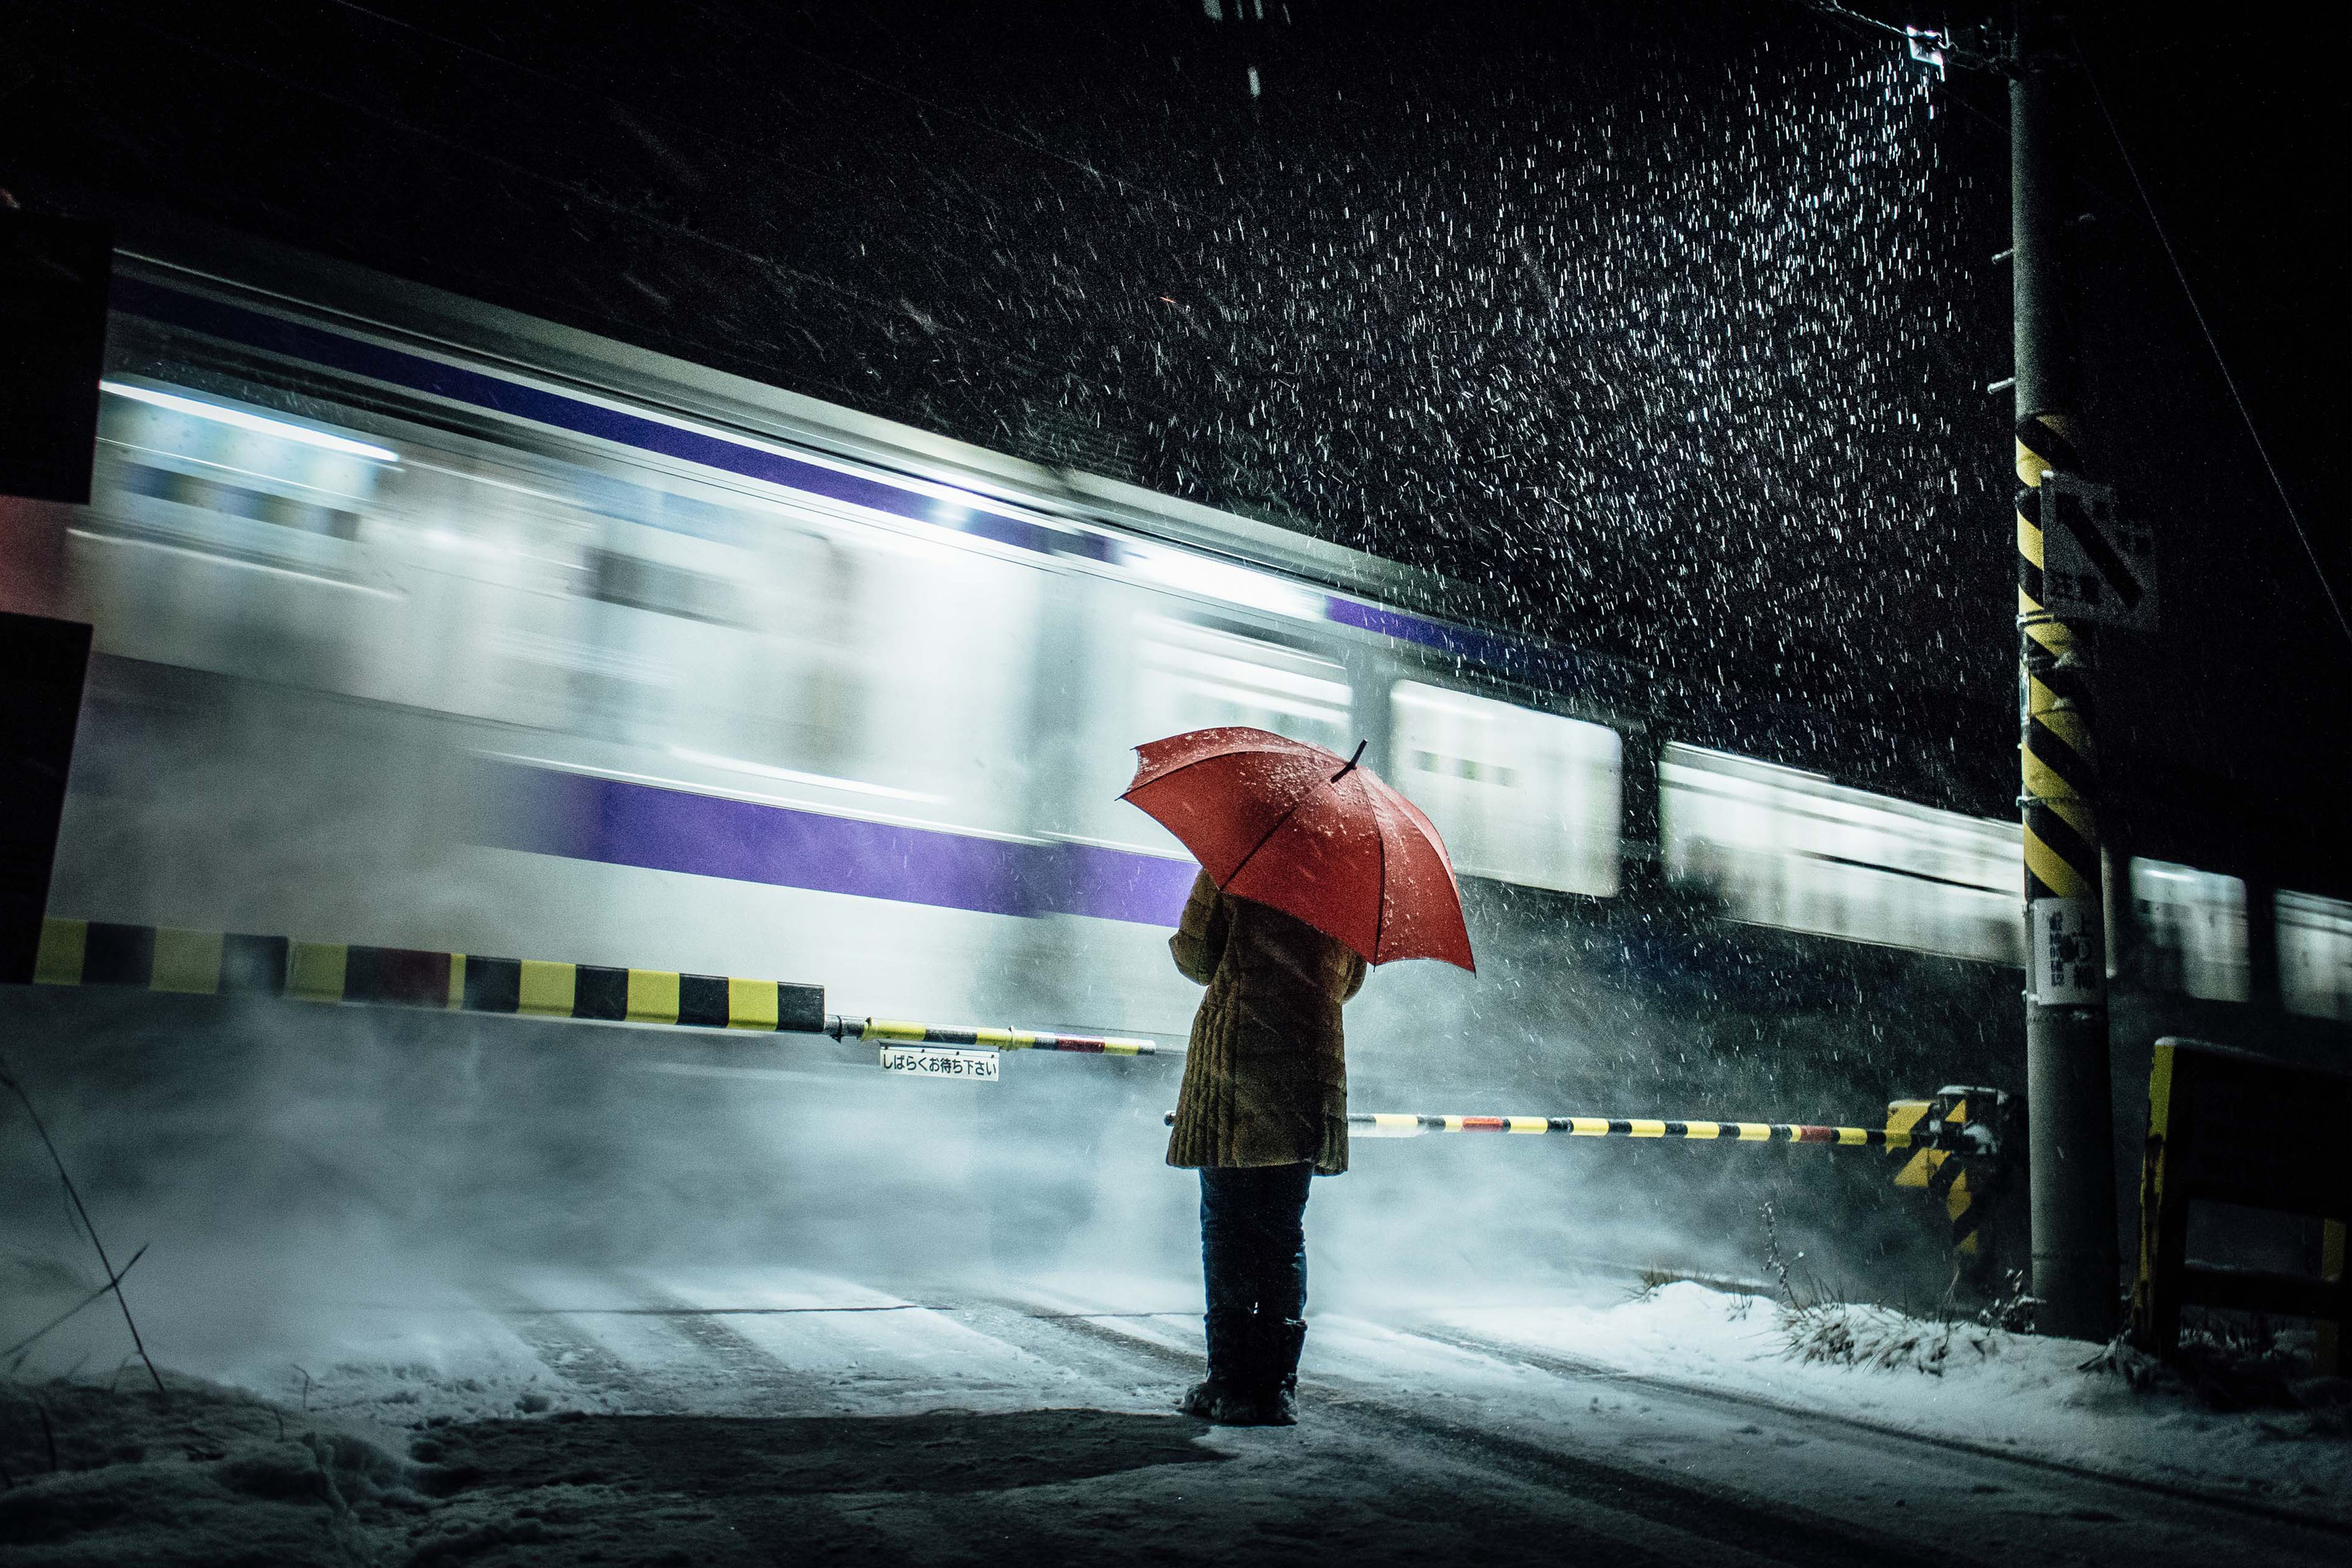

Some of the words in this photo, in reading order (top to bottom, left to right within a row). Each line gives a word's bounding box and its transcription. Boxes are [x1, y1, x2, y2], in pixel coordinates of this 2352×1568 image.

[883, 1054, 996, 1076] しばらくお待ち下さい
